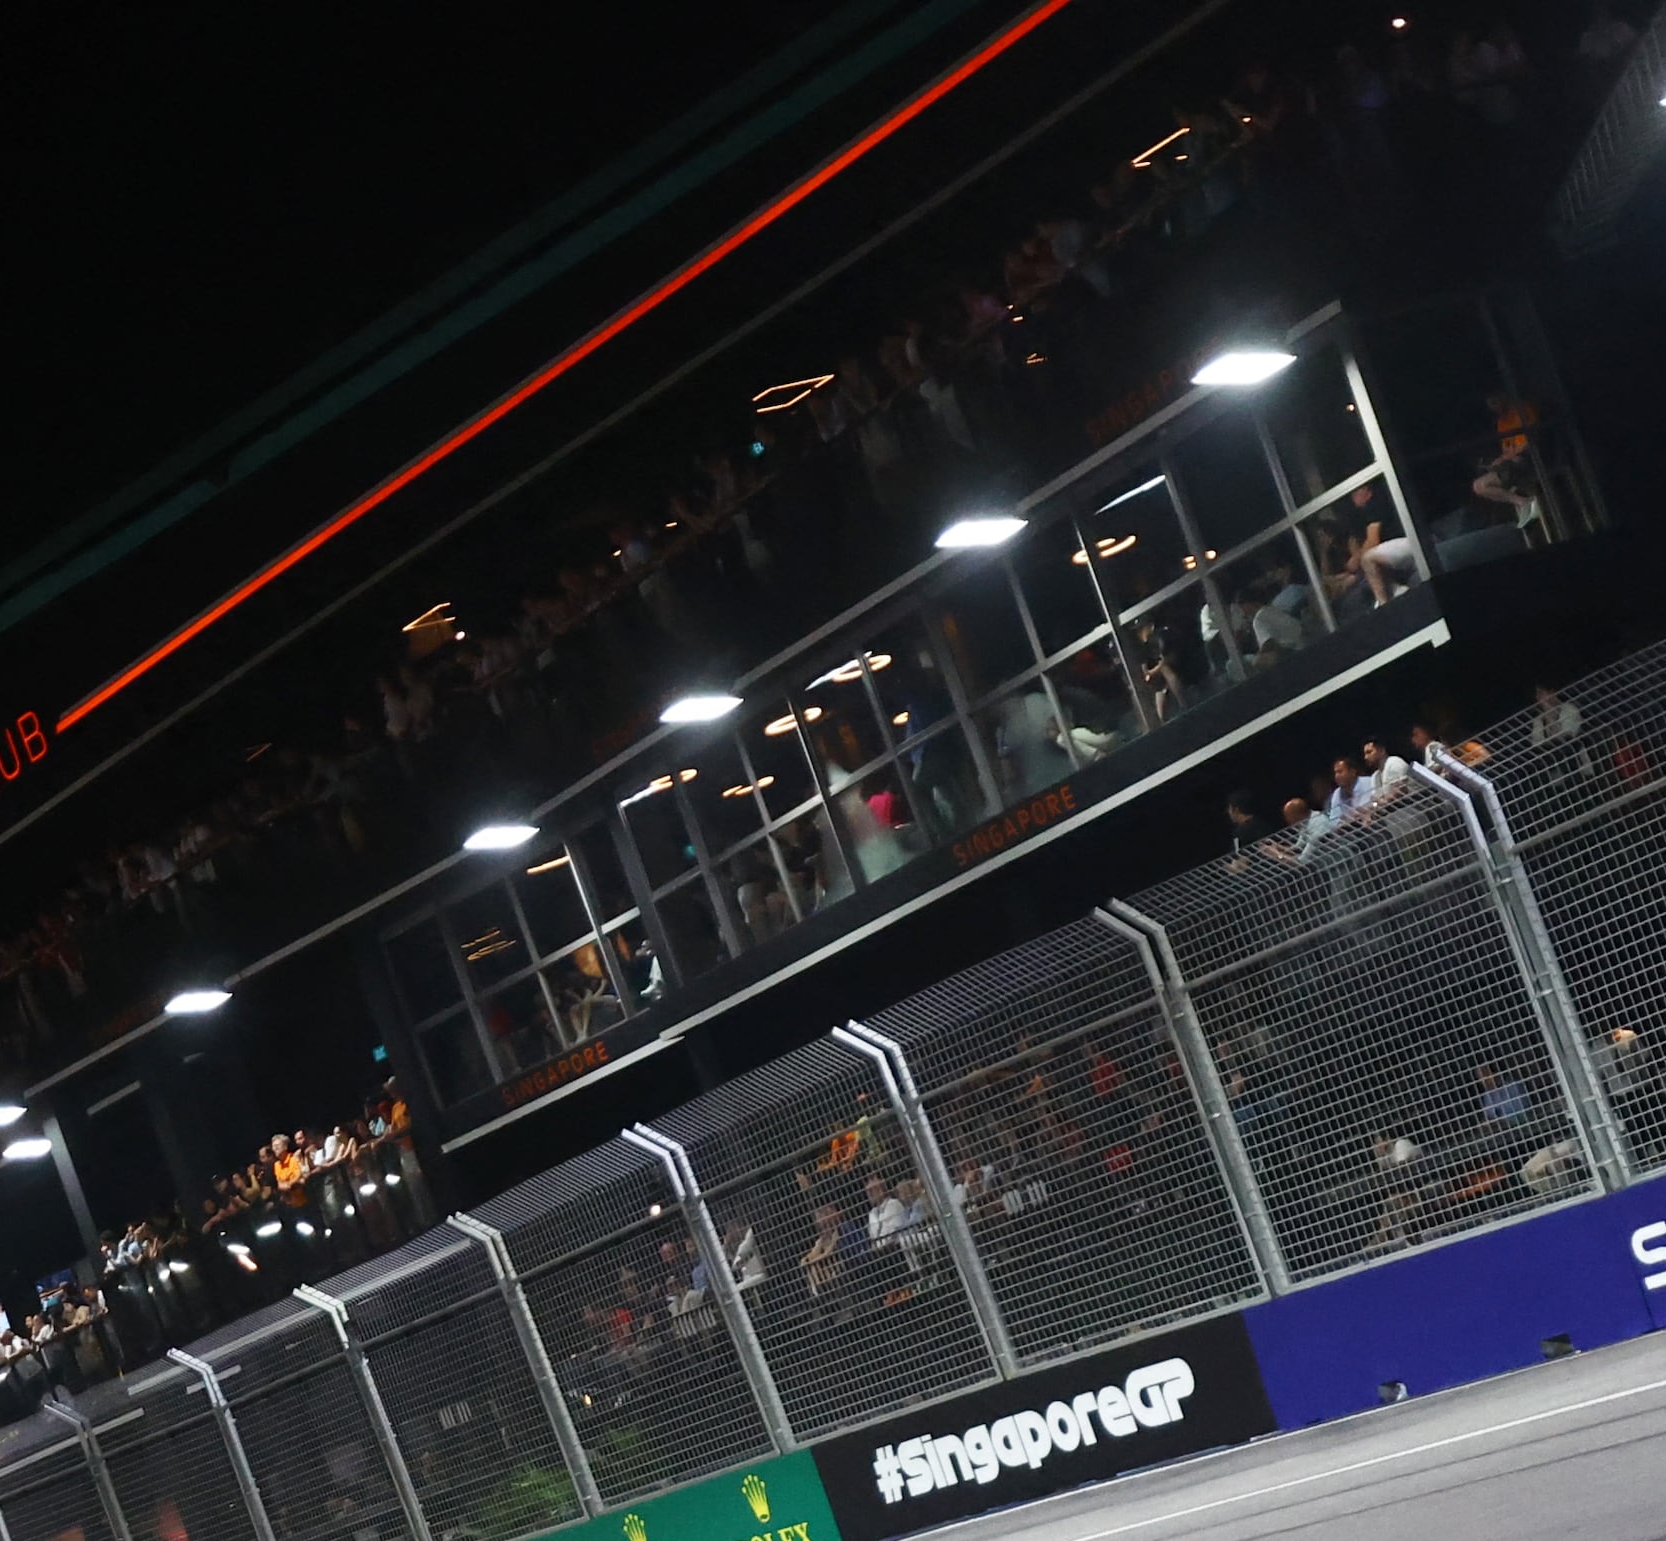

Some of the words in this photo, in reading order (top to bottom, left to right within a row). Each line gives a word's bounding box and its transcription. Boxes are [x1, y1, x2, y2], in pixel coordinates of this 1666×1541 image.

[952, 785, 1077, 864] SINGAPORE
[500, 1040, 610, 1109] SINGAPORE
[873, 1356, 1195, 1504] #SingaporeGP
